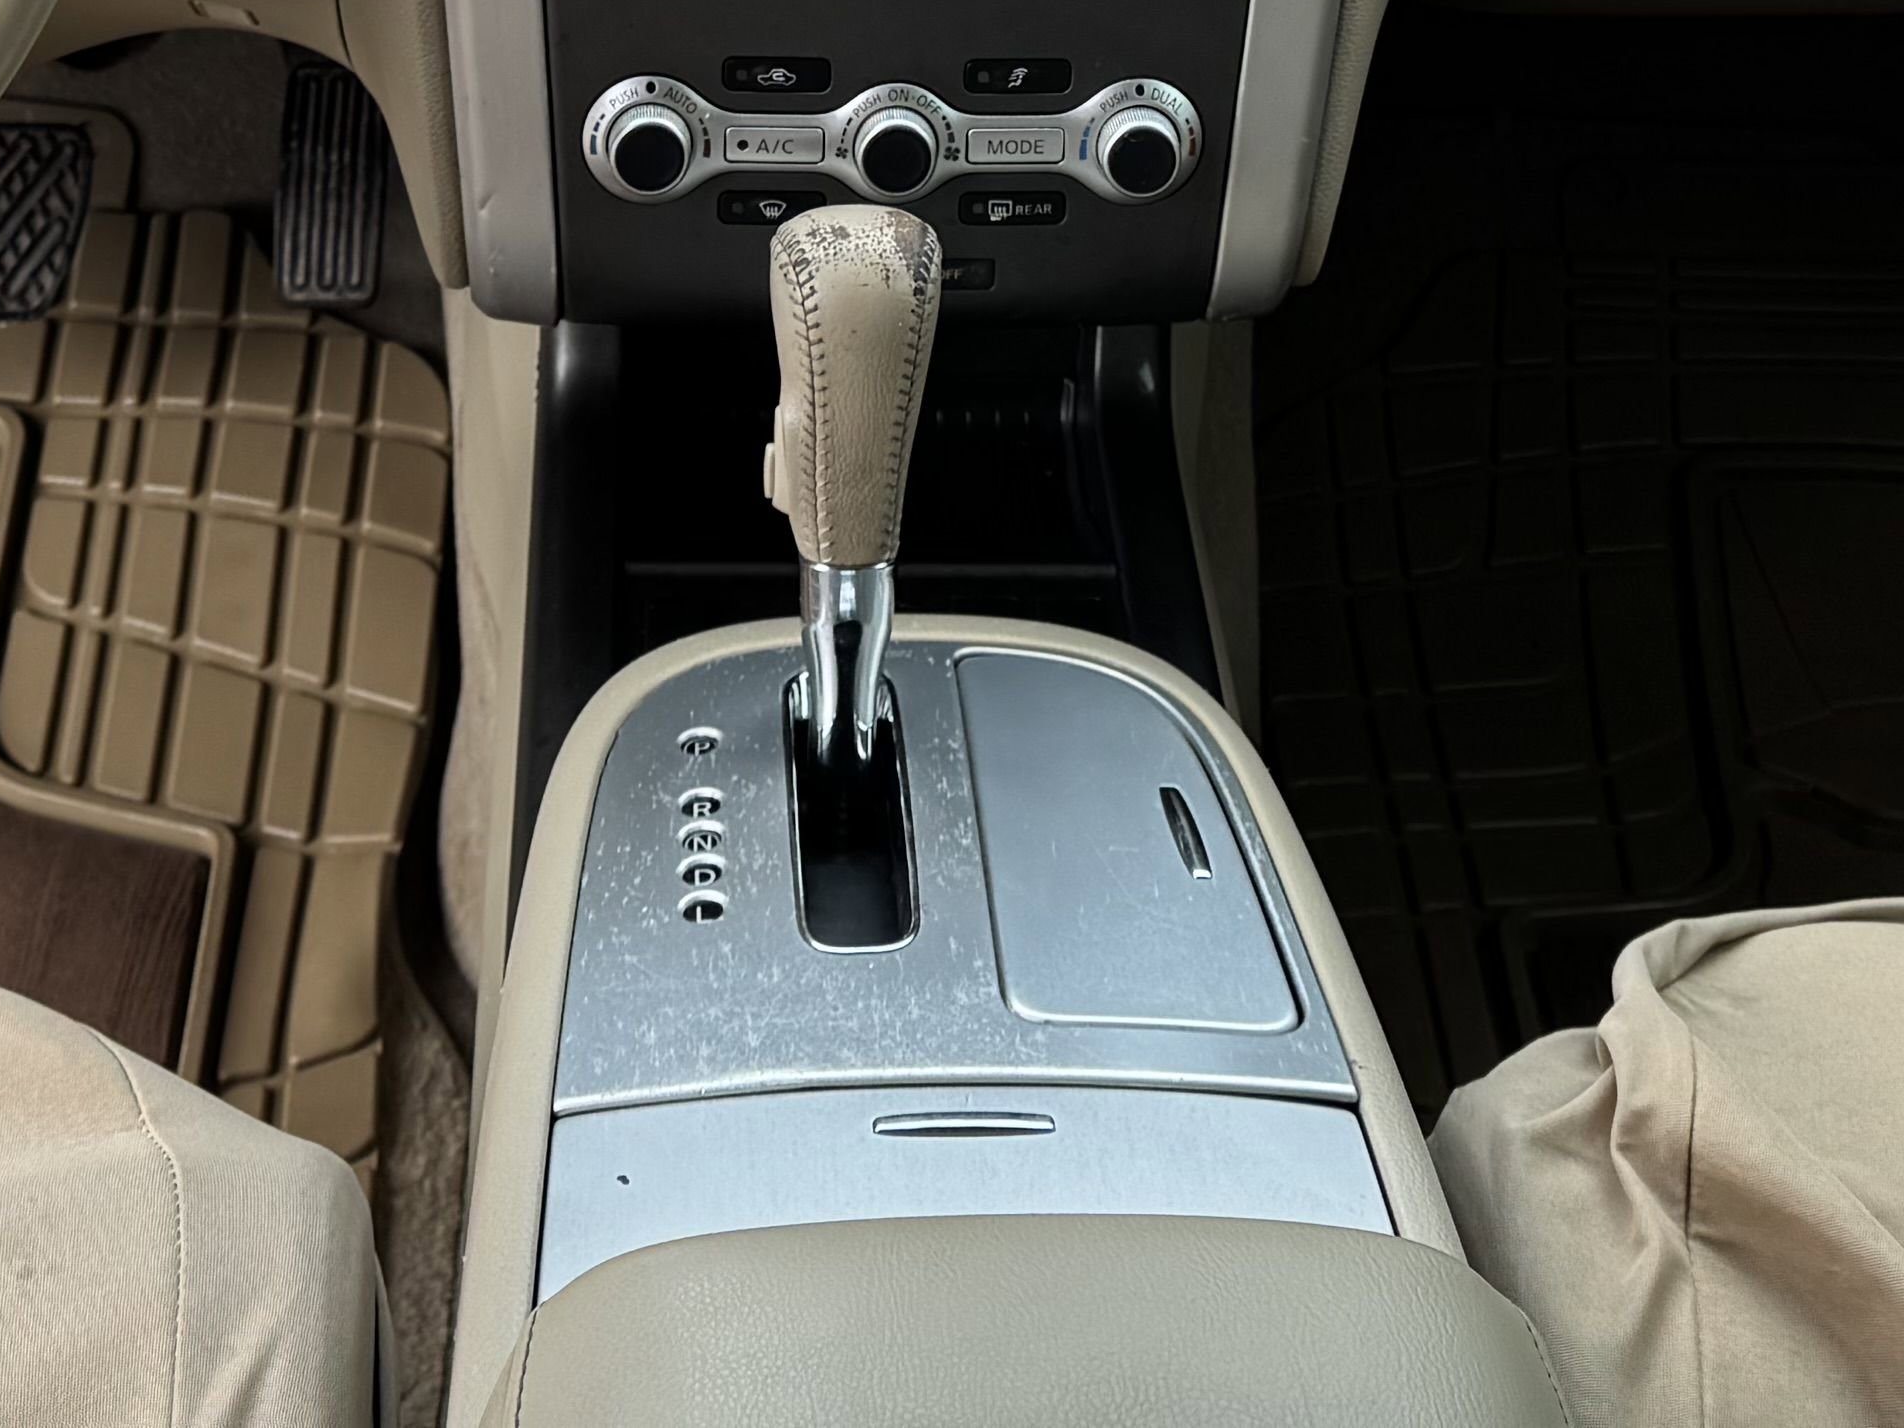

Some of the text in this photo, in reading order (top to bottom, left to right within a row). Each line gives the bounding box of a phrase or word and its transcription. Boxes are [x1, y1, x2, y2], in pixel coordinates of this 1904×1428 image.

[609, 86, 697, 114] PUSH AUTO
[852, 94, 882, 119] PUSH
[1099, 87, 1183, 115] PUSH DUAL
[755, 139, 795, 154] A/C
[987, 140, 1045, 155] MODE
[1015, 204, 1052, 215] REAR
[694, 742, 711, 756] P
[692, 802, 712, 819] R
[693, 835, 712, 853] N
[694, 868, 716, 886] D
[696, 905, 715, 924] L
